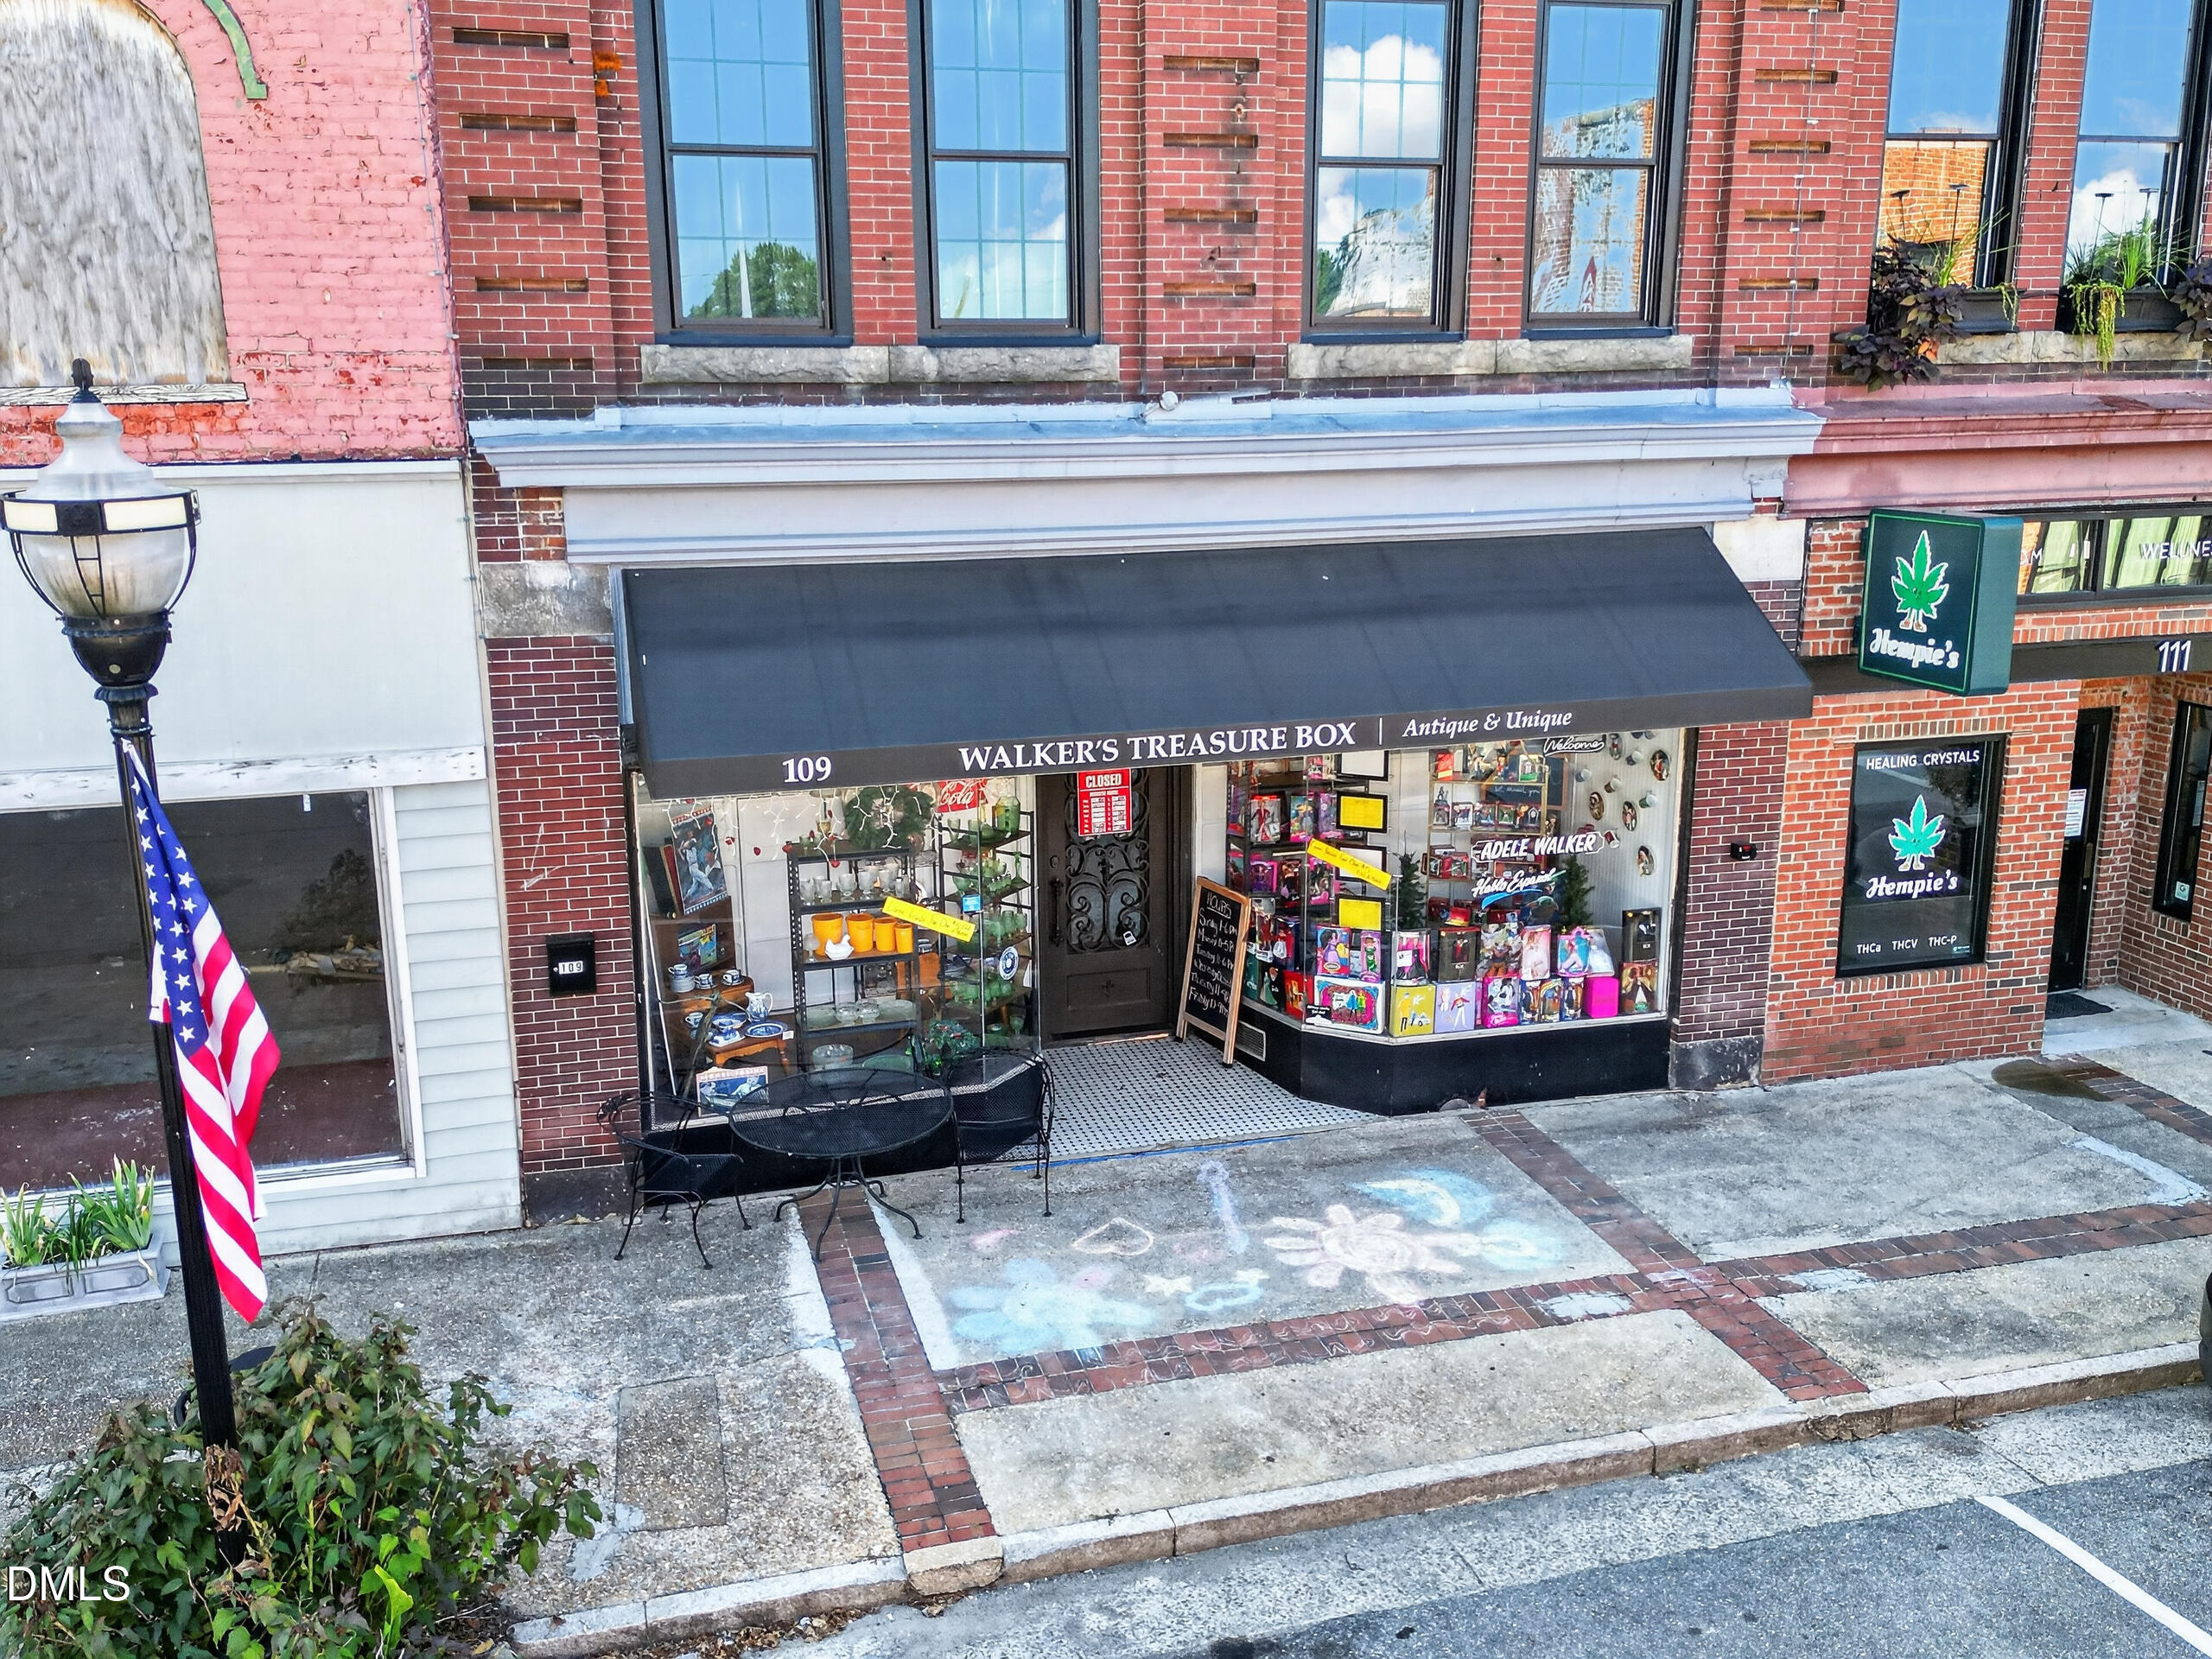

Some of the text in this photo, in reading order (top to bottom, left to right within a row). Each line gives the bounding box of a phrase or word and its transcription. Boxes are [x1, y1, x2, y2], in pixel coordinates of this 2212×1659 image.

[2140, 540, 2212, 560] WELLNE
[1869, 628, 1960, 669] Hempie's
[2158, 640, 2191, 672] 111
[1402, 709, 1573, 739] Antique & Unique
[958, 722, 1357, 772] WALKER'S TREASURE BOX
[1866, 749, 1980, 770] HEALING CRYSTALS
[782, 756, 832, 784] 109
[1085, 773, 1122, 788] CLOSED
[1480, 834, 1596, 860] ADELE WALKER
[1471, 877, 1508, 898] Hablo
[1866, 868, 1958, 899] Hempie's
[1856, 935, 1957, 954] THCa THCV THC-P
[562, 962, 582, 973] 109
